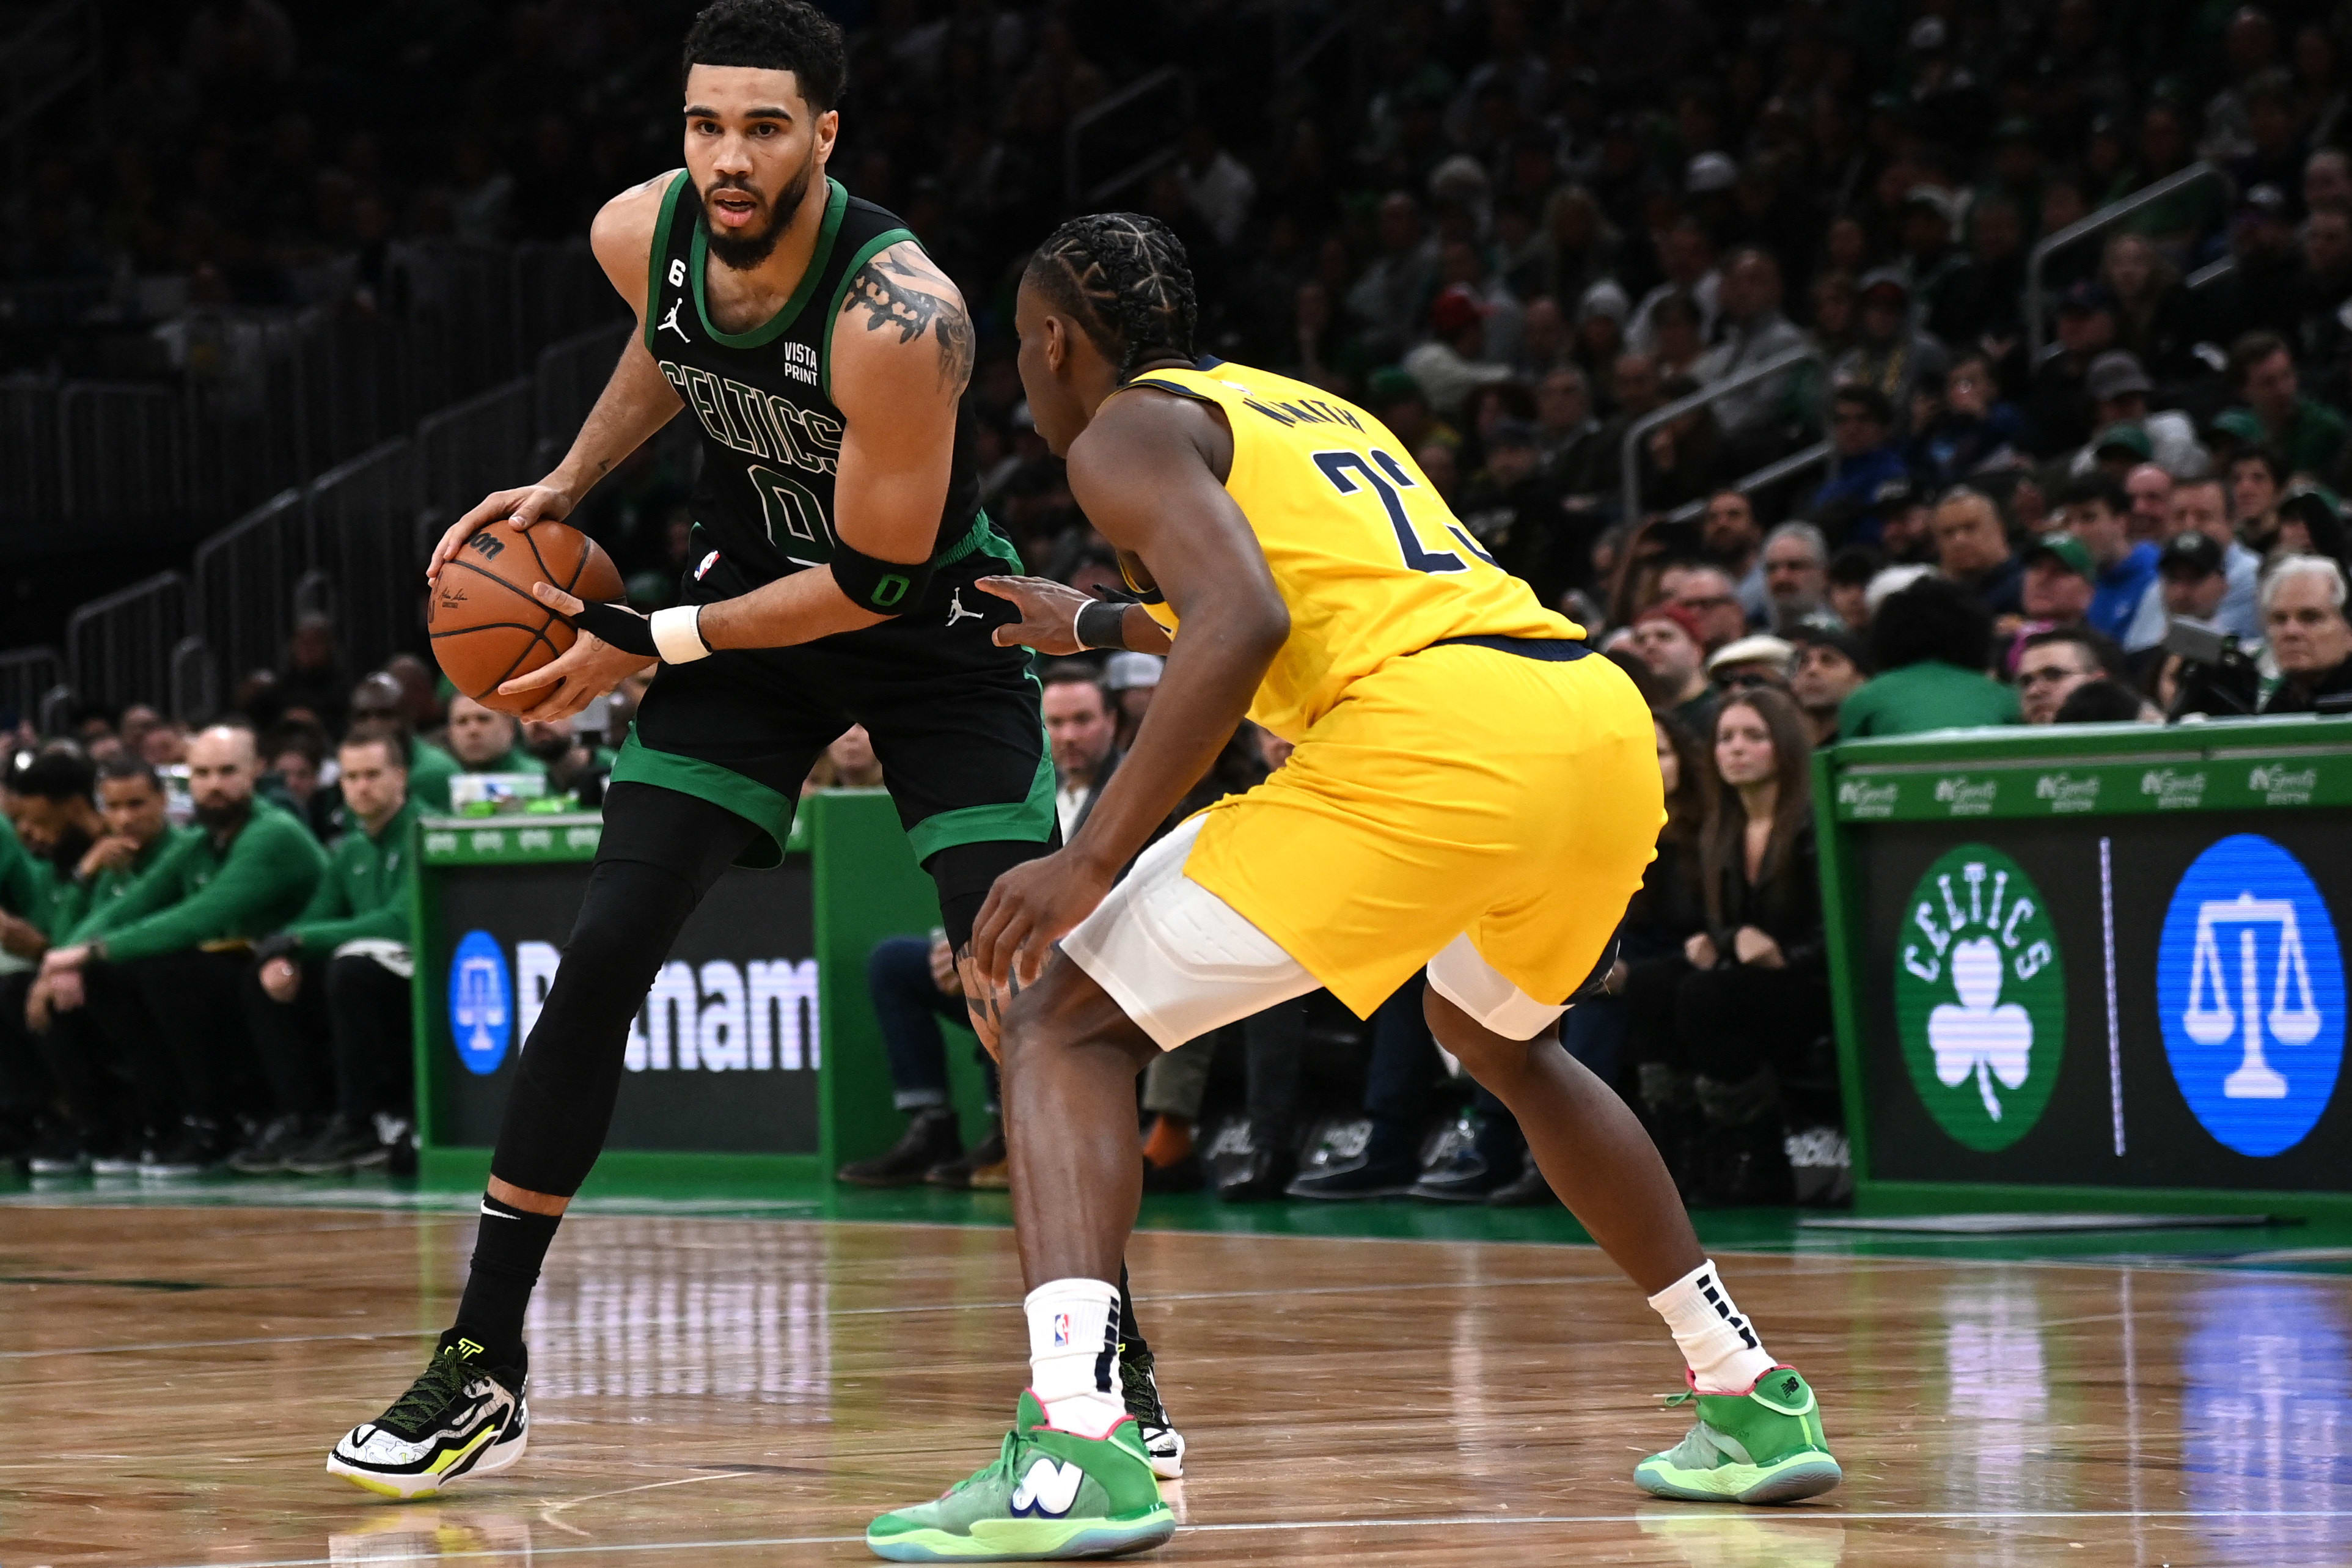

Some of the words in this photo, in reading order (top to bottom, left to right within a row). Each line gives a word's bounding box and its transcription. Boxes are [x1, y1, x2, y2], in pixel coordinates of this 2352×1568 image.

[669, 258, 686, 288] 6
[784, 341, 818, 372] VISTA
[784, 362, 818, 387] PRINT
[747, 464, 835, 567] 0
[871, 573, 910, 606] 0
[1903, 861, 2052, 983] CELTICS
[516, 939, 821, 1073] Pnam
